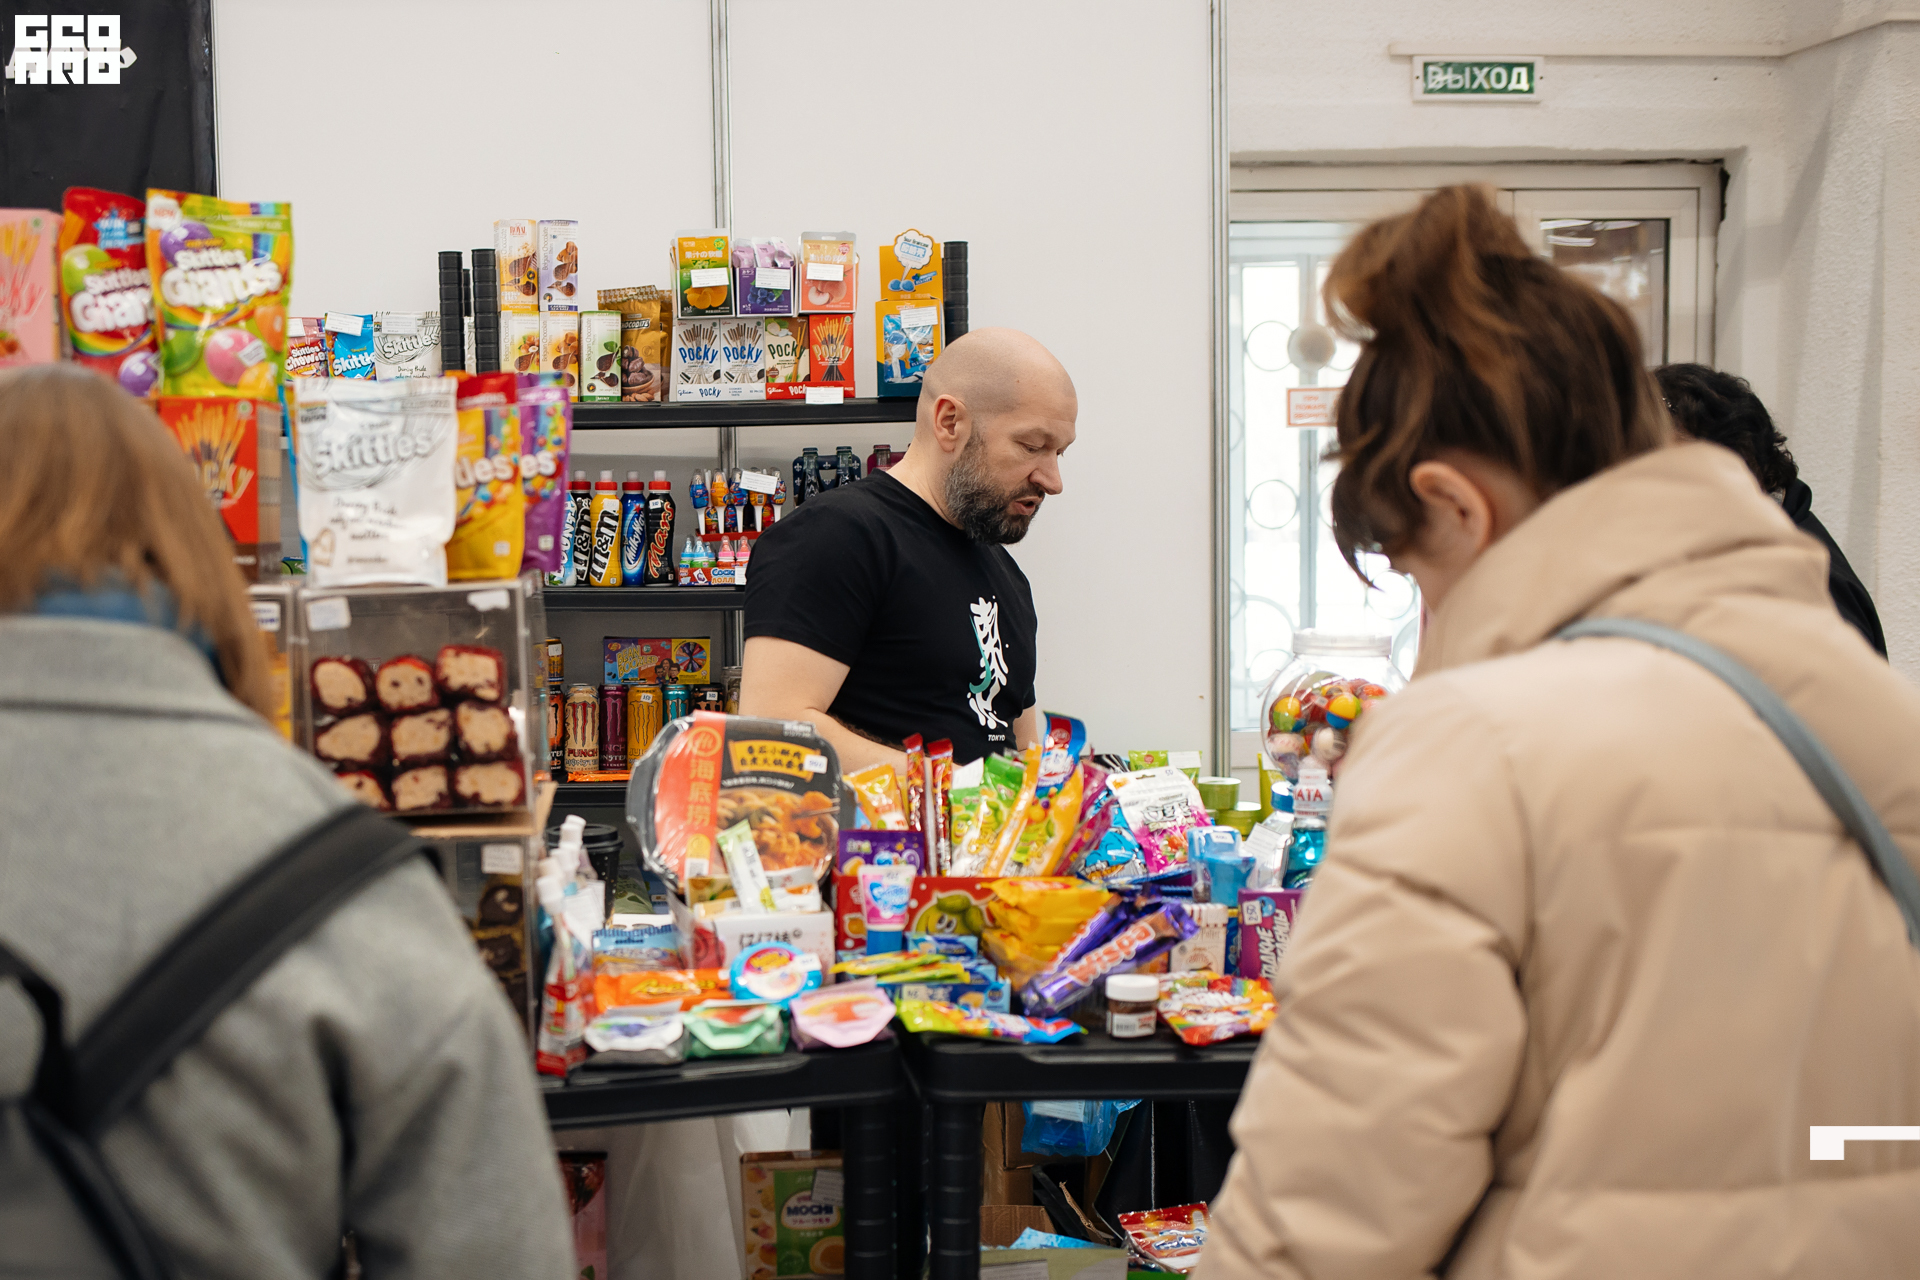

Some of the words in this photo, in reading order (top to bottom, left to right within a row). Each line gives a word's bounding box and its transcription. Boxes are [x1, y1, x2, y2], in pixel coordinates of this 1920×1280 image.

[1427, 65, 1530, 92] ВЫХОД
[84, 267, 152, 295] Skittle
[70, 288, 153, 333] Gian
[291, 345, 320, 358] Skittles
[384, 333, 440, 359] Skittles
[313, 430, 434, 480] Skittles
[647, 501, 674, 578] Mars
[617, 644, 641, 662] BEAN
[617, 656, 659, 679] BOOZLED
[988, 734, 1006, 742] TOKYO
[565, 759, 598, 767] MONSTE
[567, 748, 598, 758] PUNCH
[685, 758, 716, 828] 海底捞
[786, 1204, 834, 1217] MOCHI
